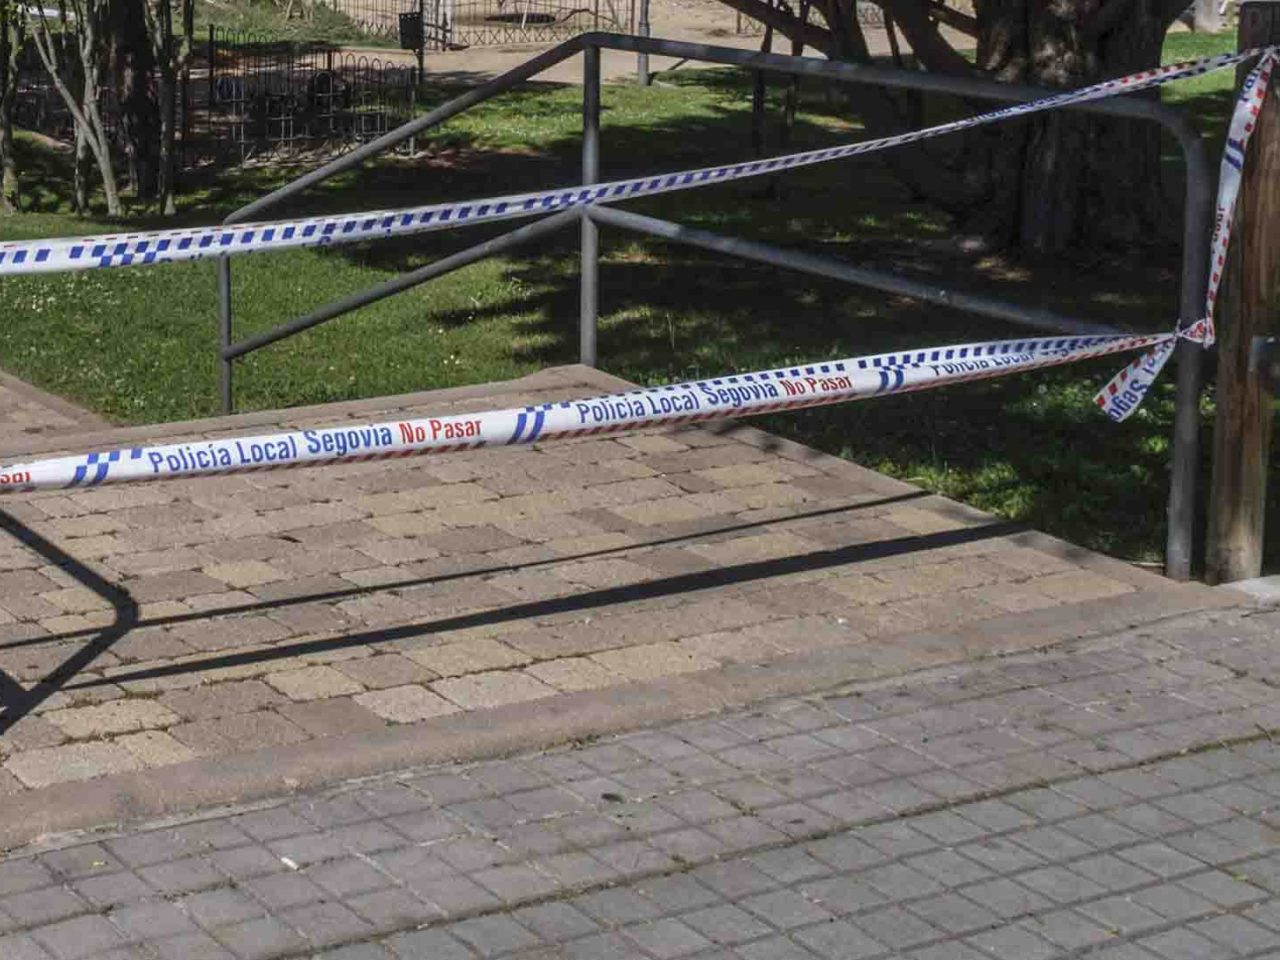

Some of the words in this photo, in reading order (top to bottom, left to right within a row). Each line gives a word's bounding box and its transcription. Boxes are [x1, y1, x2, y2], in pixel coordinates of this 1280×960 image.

[646, 392, 700, 415] Local
[701, 380, 778, 408] Segovia
[780, 378, 806, 397] No
[807, 374, 853, 393] Pasar
[148, 442, 232, 473] Policía
[236, 435, 297, 465] Local
[303, 423, 393, 457] Segovia
[399, 422, 426, 445] No
[429, 418, 482, 441] Pasar
